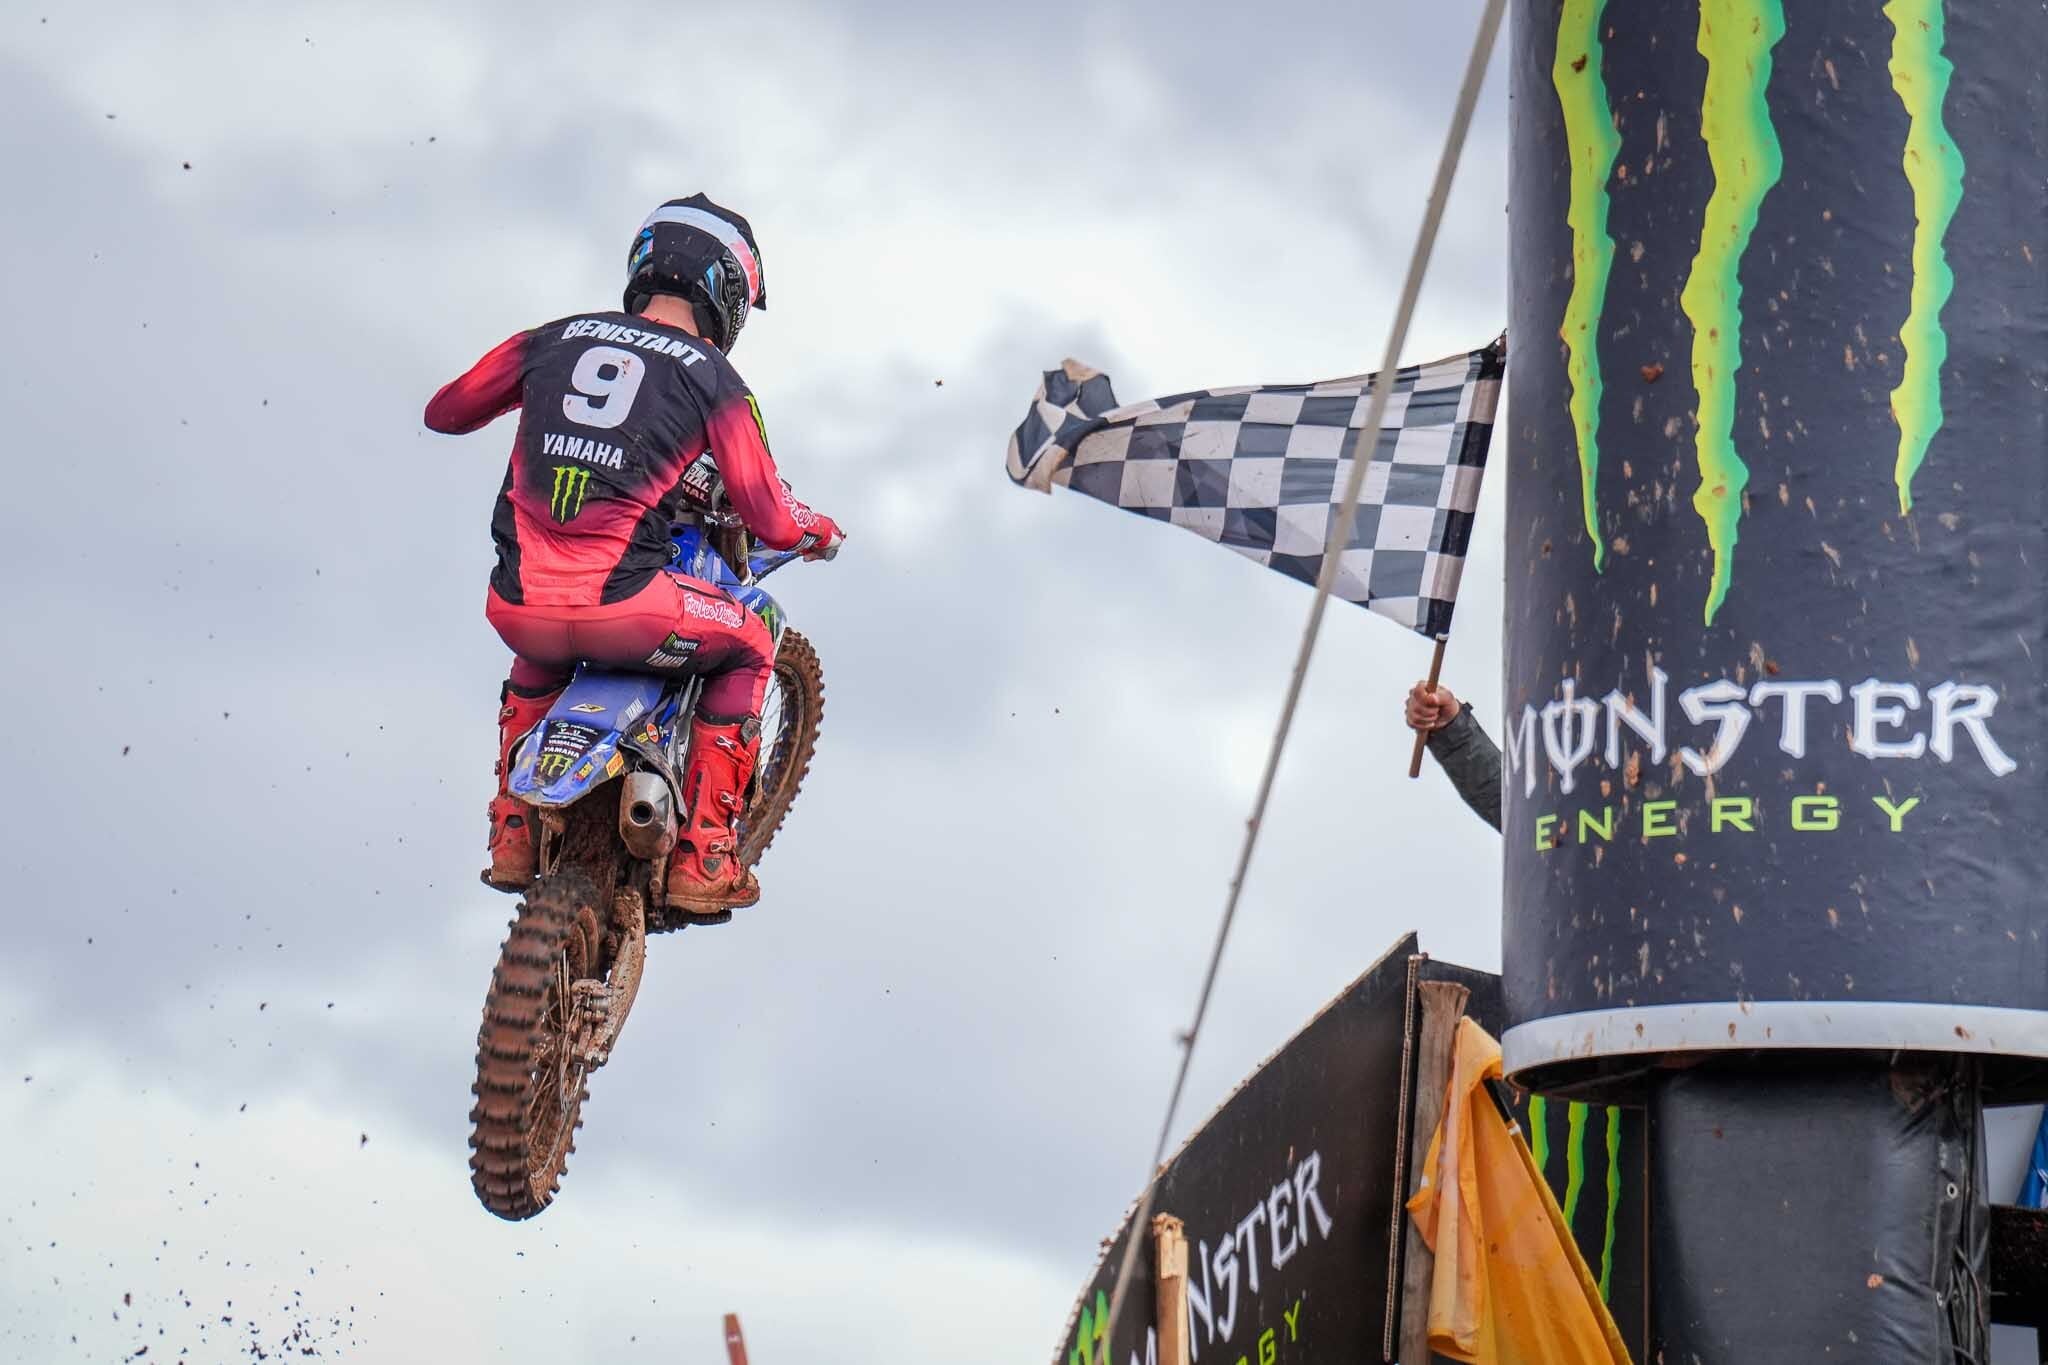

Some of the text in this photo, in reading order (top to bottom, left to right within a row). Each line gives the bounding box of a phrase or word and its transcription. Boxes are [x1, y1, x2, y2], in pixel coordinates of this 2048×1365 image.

[561, 319, 707, 367] BENISTANT
[562, 346, 646, 429] 9
[542, 433, 625, 470] YAMAHA
[645, 648, 688, 667] YAMAHA
[543, 746, 580, 759] YAMAHA
[1505, 667, 2017, 798] MONSTER
[1535, 795, 1921, 852] ENERGY
[1130, 1149, 1333, 1365] NSTER
